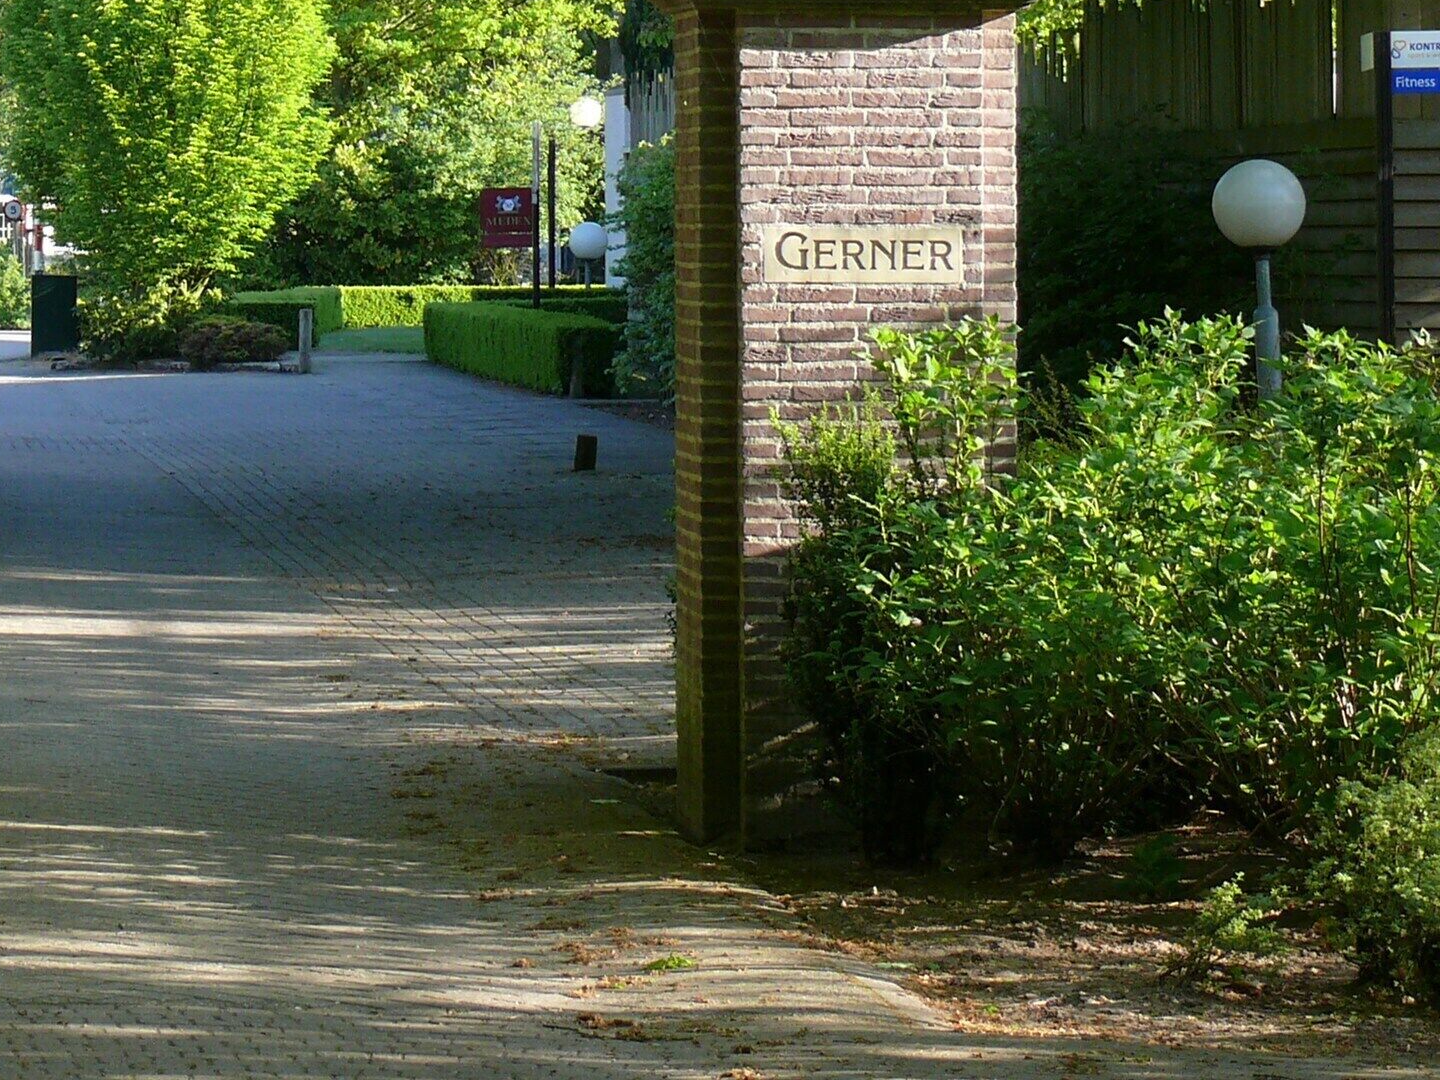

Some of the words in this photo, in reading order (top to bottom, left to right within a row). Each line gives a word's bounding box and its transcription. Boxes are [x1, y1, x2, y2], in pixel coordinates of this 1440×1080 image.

[1395, 75, 1436, 88] Fitness
[10, 205, 17, 214] 5
[774, 231, 954, 270] GERNER
